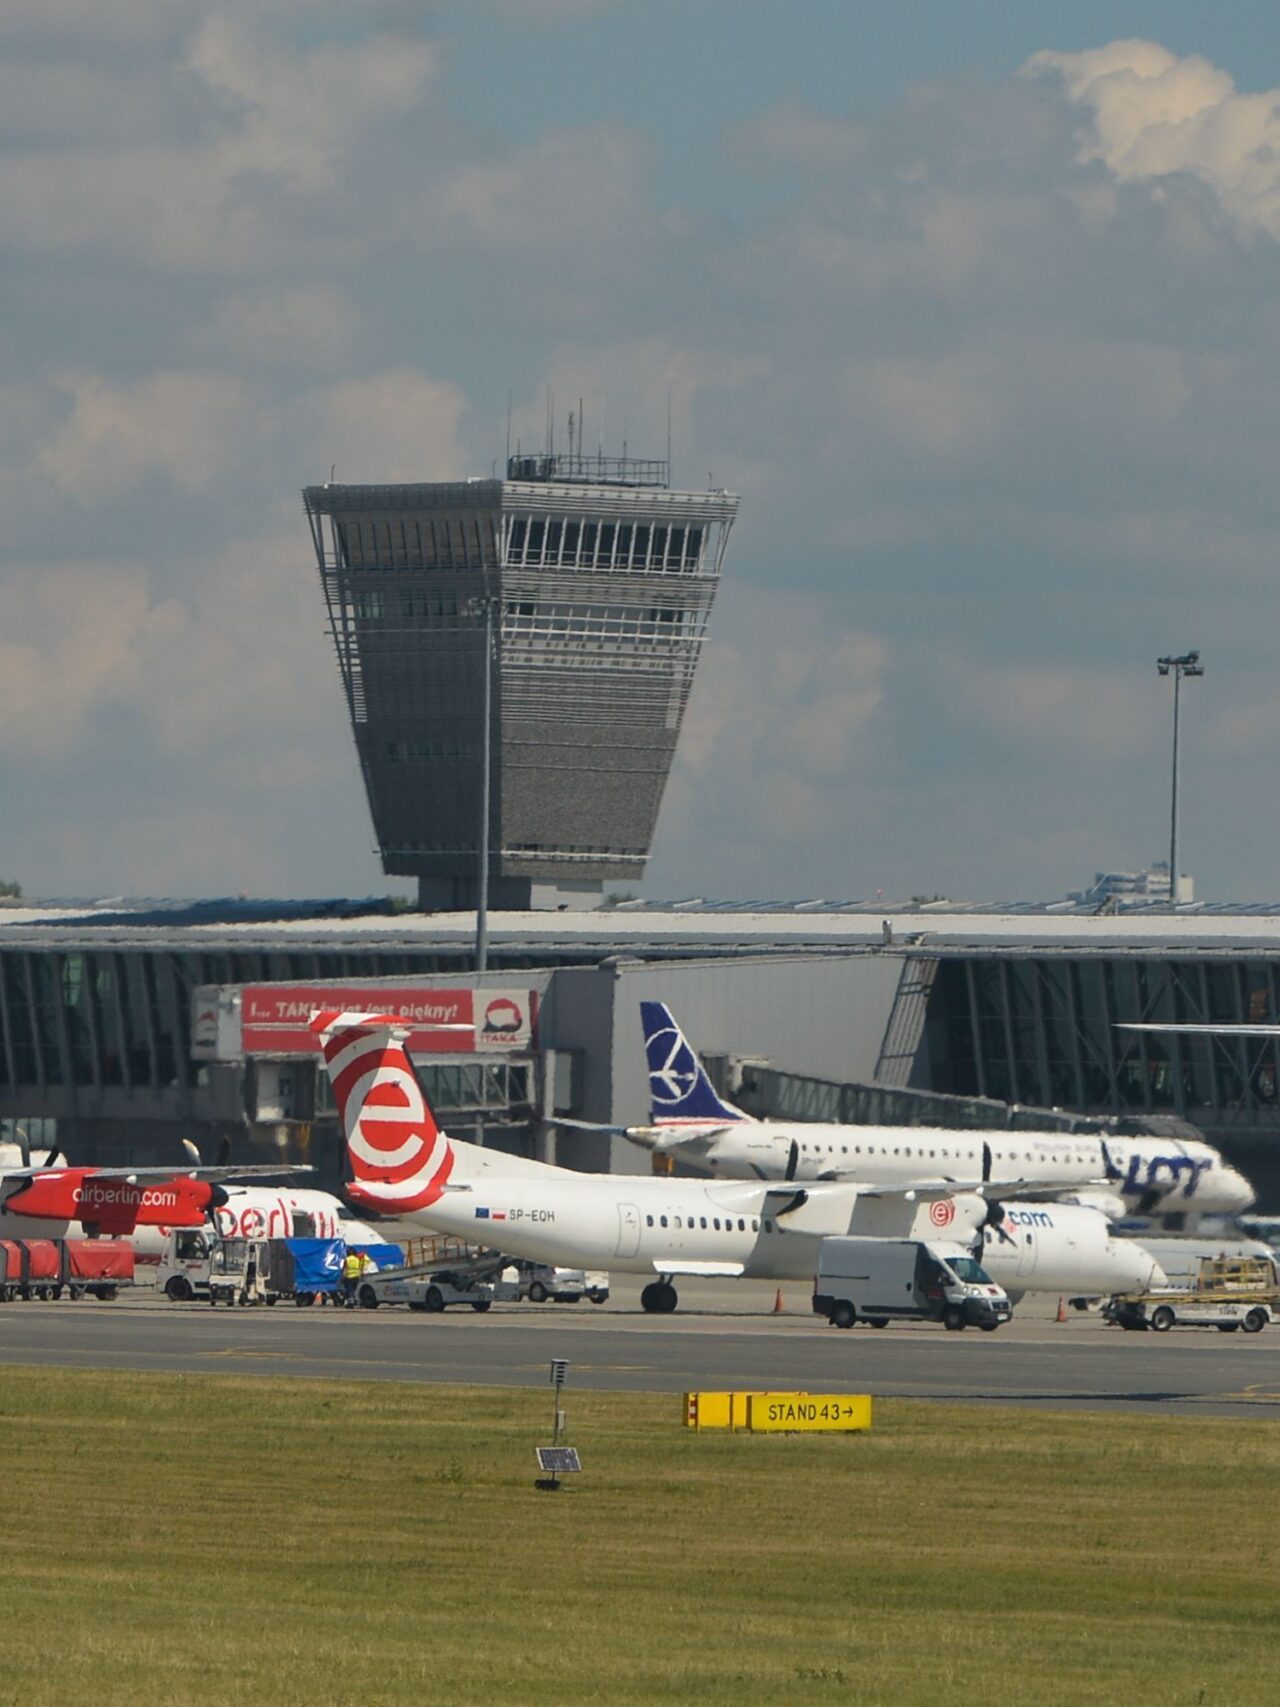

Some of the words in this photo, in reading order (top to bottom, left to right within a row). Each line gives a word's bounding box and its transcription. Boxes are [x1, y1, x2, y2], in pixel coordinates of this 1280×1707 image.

[481, 1033, 518, 1043] ITAKA
[72, 1184, 176, 1206] airberlin.com
[768, 1403, 817, 1421] STAND
[819, 1403, 840, 1421] 43
